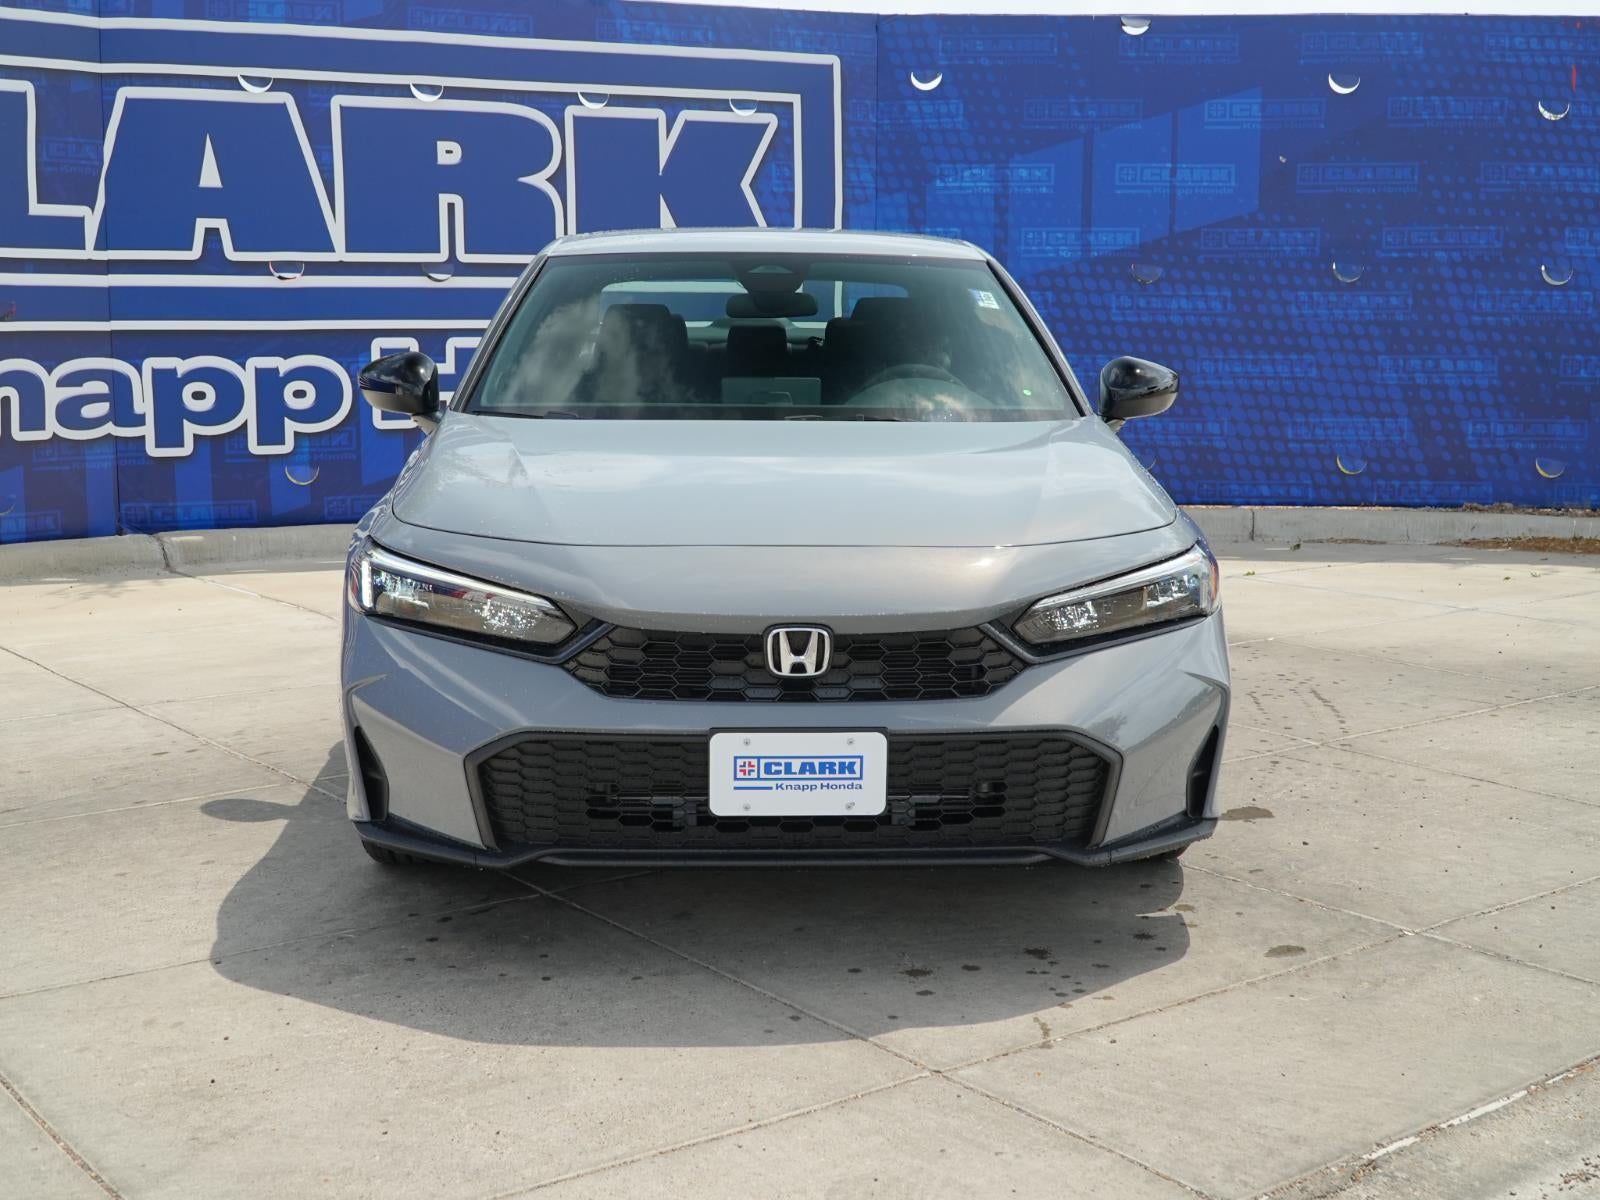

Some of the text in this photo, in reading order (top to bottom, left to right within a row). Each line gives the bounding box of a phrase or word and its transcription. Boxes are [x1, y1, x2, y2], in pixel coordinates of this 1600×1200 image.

[1142, 168, 1229, 181] CLARK
[764, 761, 857, 776] CLARK
[775, 782, 863, 792] Knapp Honda
